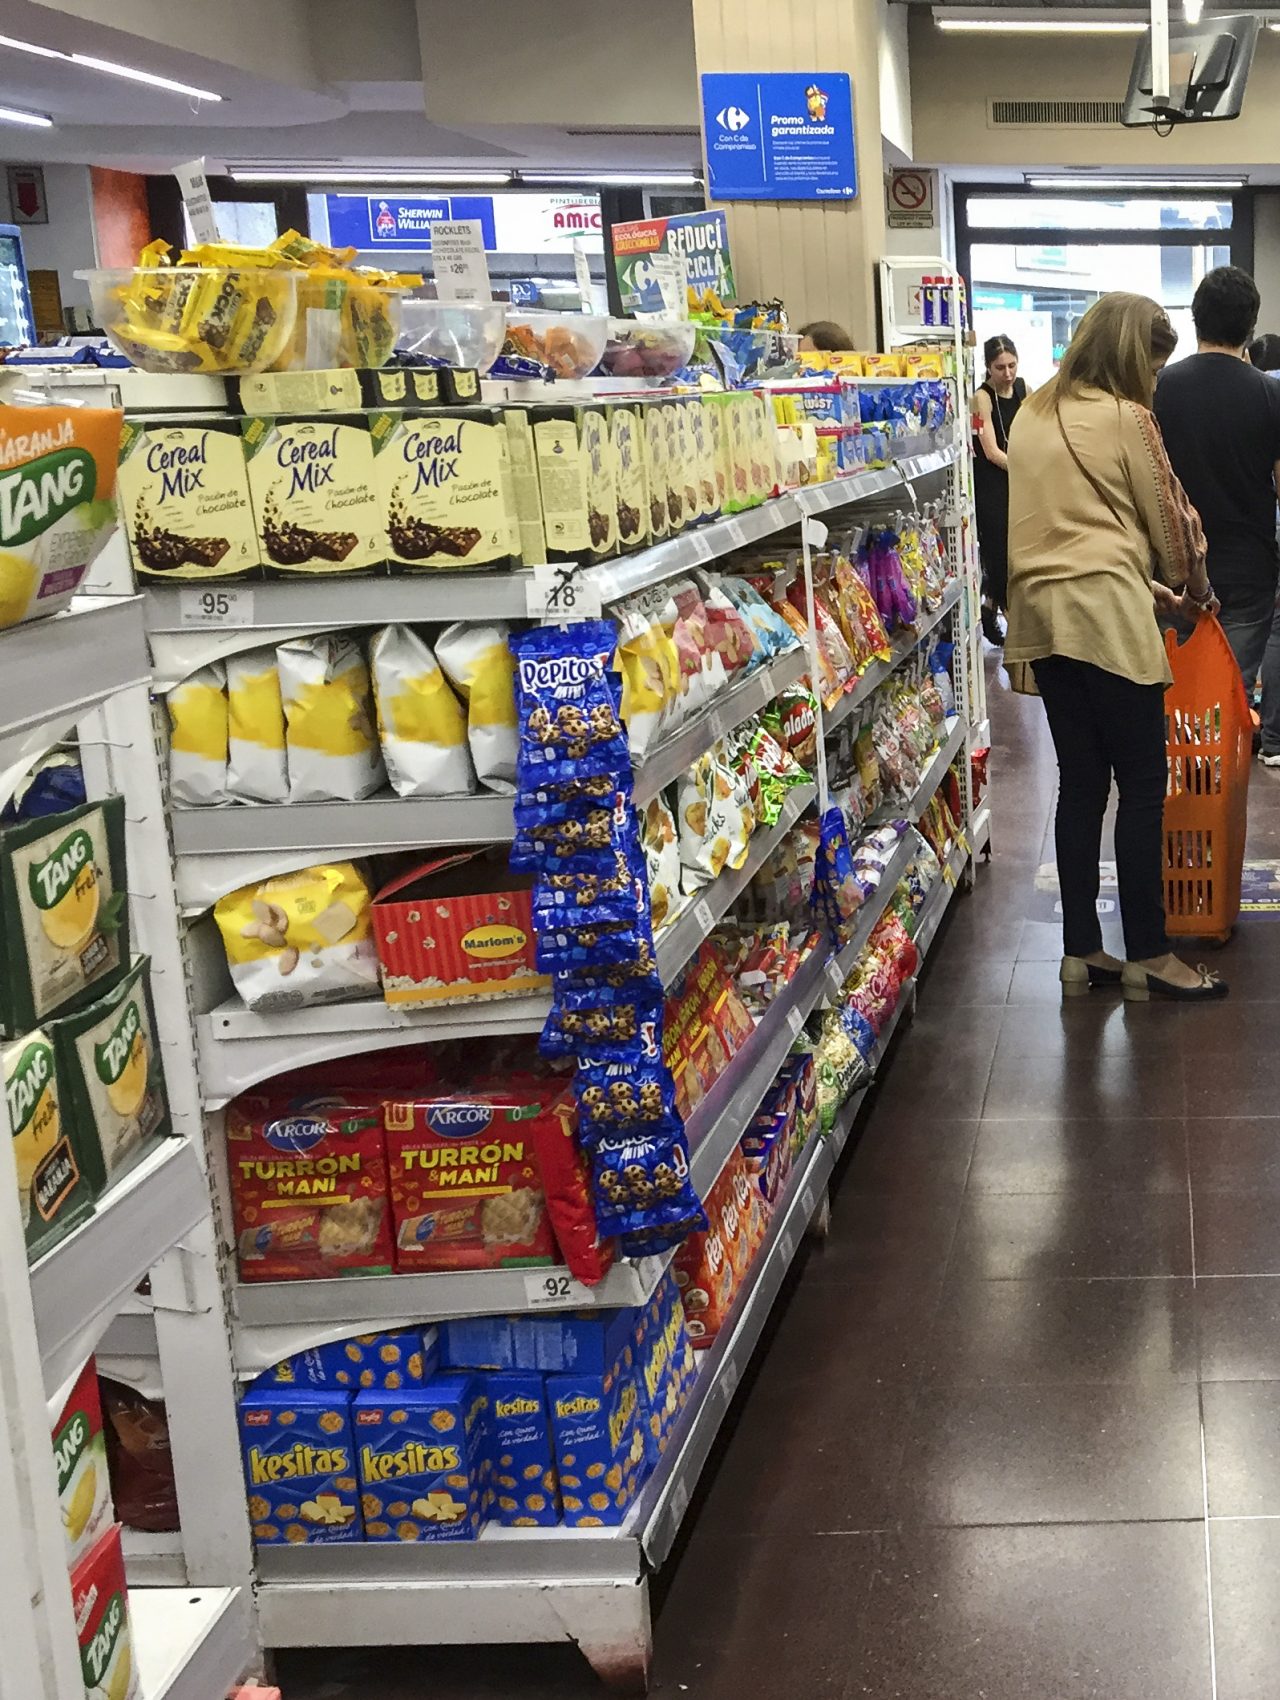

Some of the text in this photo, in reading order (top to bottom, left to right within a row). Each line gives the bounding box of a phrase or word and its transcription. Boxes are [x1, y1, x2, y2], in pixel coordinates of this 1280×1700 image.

[771, 115, 804, 124] Promo
[771, 125, 834, 137] garantizada
[398, 208, 443, 219] SHERWIN
[398, 219, 431, 229] WILLIA
[434, 226, 472, 235] ROCKLETS
[147, 432, 208, 472] Cereal
[278, 427, 340, 467] Cereal
[403, 421, 465, 462] Cereal
[157, 468, 204, 505] Mix
[286, 463, 334, 500] Mix
[411, 458, 459, 494] Mix
[0, 459, 83, 541] TANG
[196, 499, 246, 516] Chocolate
[325, 493, 375, 510] Chocolate
[449, 488, 498, 505] Chocolate
[240, 543, 247, 553] 6
[368, 539, 375, 549] 6
[491, 533, 497, 544] 6
[36, 836, 87, 905] TANG
[102, 1007, 138, 1079] TANG
[4, 1050, 48, 1129] TANG
[266, 1120, 326, 1138] ARCOR
[429, 1108, 491, 1127] ARCOR
[239, 1152, 361, 1180] TURRÓN
[401, 1139, 524, 1170] TURRÓN
[277, 1175, 337, 1195] MANÍ
[439, 1163, 500, 1186] MANÍ
[721, 1198, 739, 1243] Rex
[705, 1224, 725, 1276] Rex
[55, 1417, 84, 1477] ANG
[86, 1599, 120, 1681] TANG
